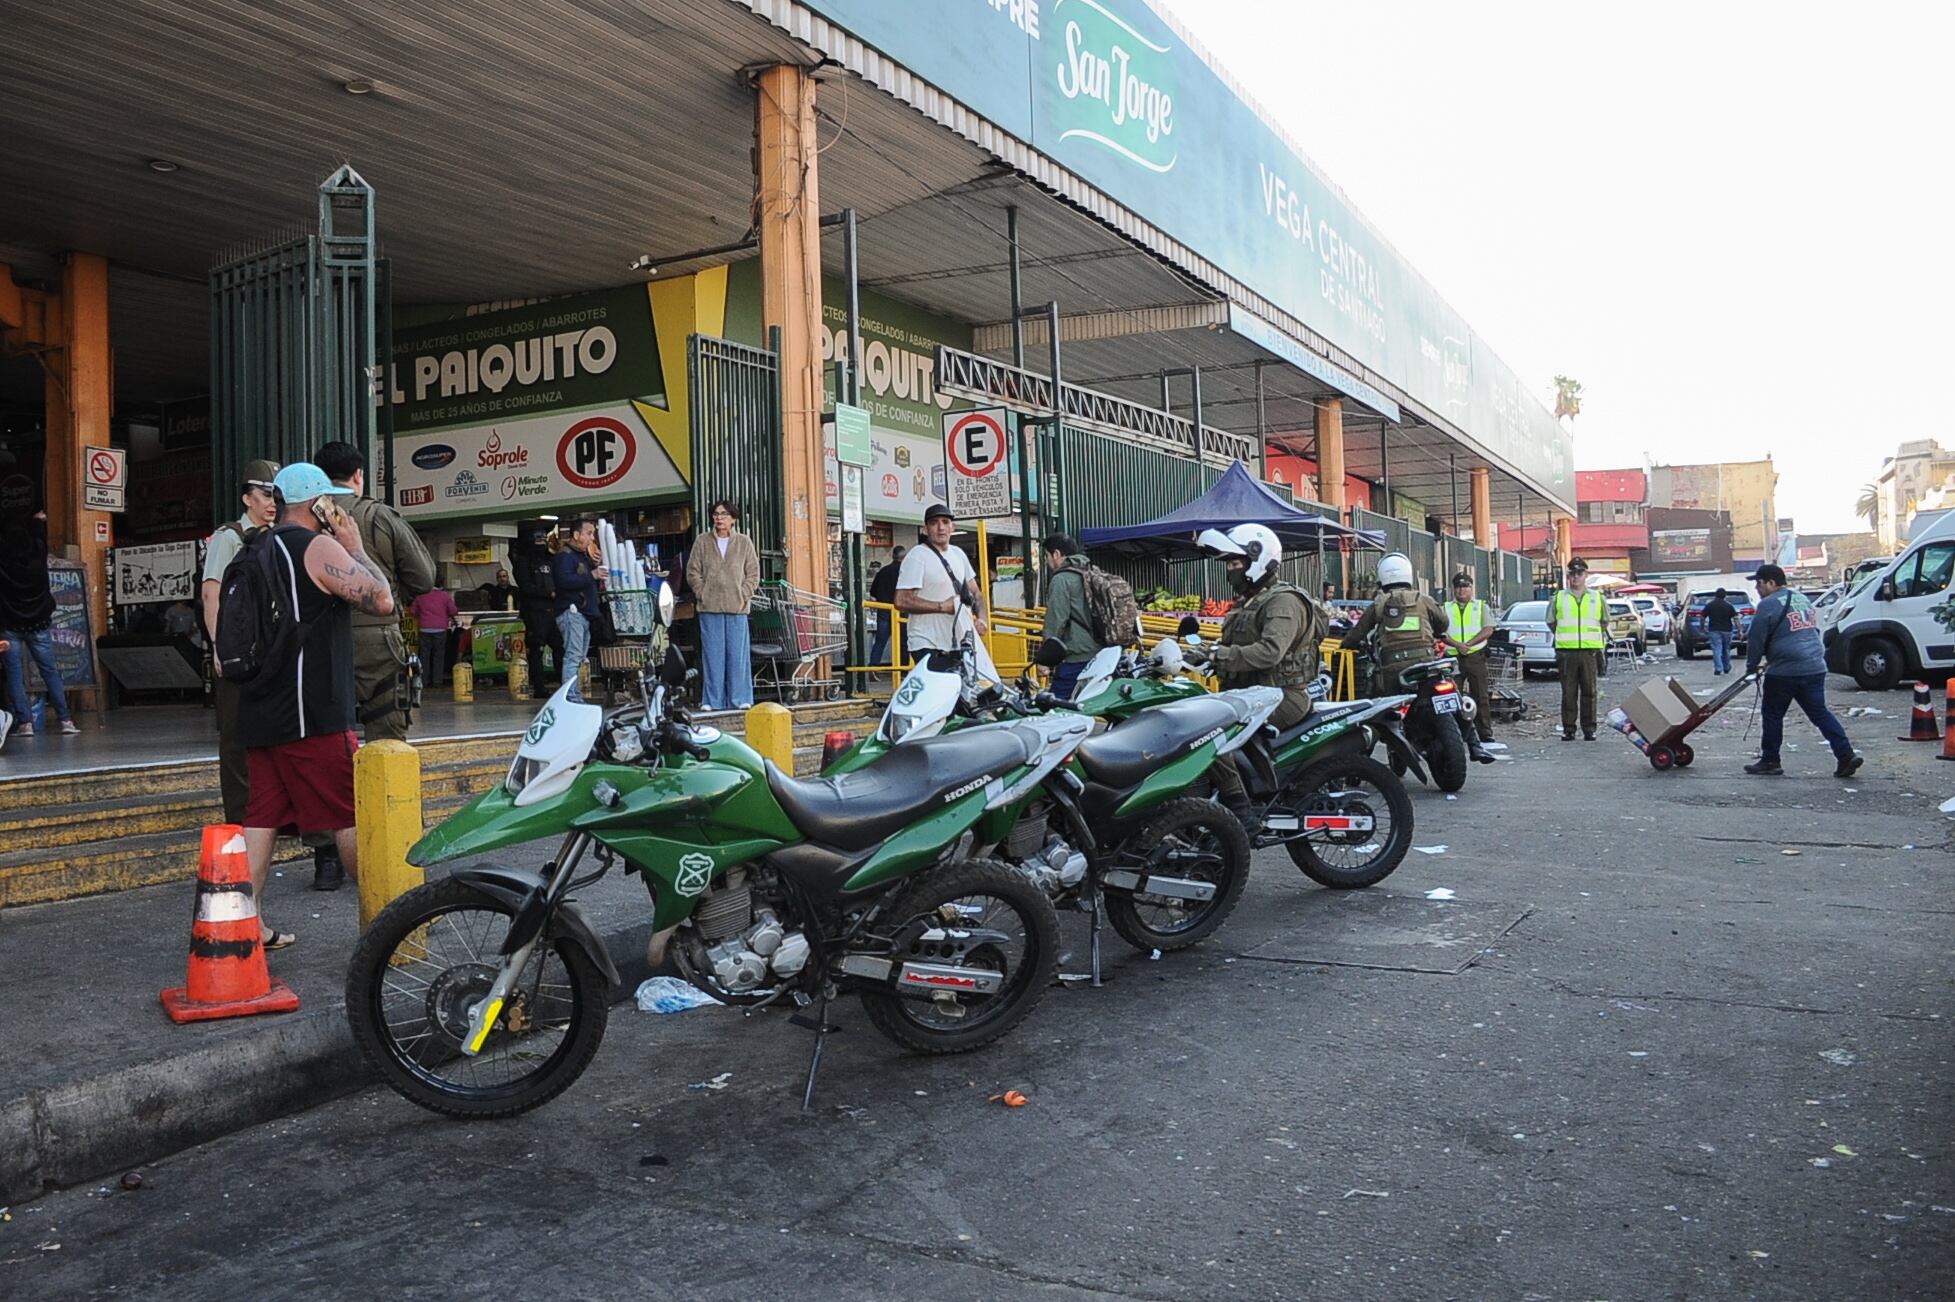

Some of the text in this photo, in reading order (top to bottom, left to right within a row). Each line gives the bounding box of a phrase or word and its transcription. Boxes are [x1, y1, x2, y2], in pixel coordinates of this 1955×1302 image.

[1057, 20, 1173, 144] San Jorge
[1260, 162, 1384, 312] VEGA CENTRAL
[1320, 268, 1386, 343] DE SANTIAGO
[416, 333, 458, 352] LACTEOS
[466, 319, 535, 342] CONGELADOS
[542, 307, 608, 329] ABARROTES
[415, 326, 617, 401] PAIQUITO
[433, 408, 445, 420] DE
[460, 401, 487, 416] AÑOS
[489, 400, 502, 411] DE
[504, 390, 563, 410] CONFIANZA
[875, 402, 888, 418] DE
[889, 406, 935, 429] CONFIANZA
[478, 445, 529, 470] Soprole
[575, 429, 616, 476] PF
[965, 426, 988, 464] E
[448, 485, 487, 496] PORVENIR
[518, 475, 549, 486] Minuto
[518, 484, 547, 497] Verde
[955, 482, 1004, 494] SOLO VEHICULOS
[91, 496, 116, 504] FUMAR
[955, 500, 980, 508] PRIMERA
[981, 498, 998, 506] PISTA
[966, 491, 1002, 500] EMERGENCIA
[978, 505, 1009, 515] ENSANCHE
[1320, 707, 1353, 722] HONDA
[1189, 727, 1224, 750] HONDA
[944, 774, 993, 803] HONDA
